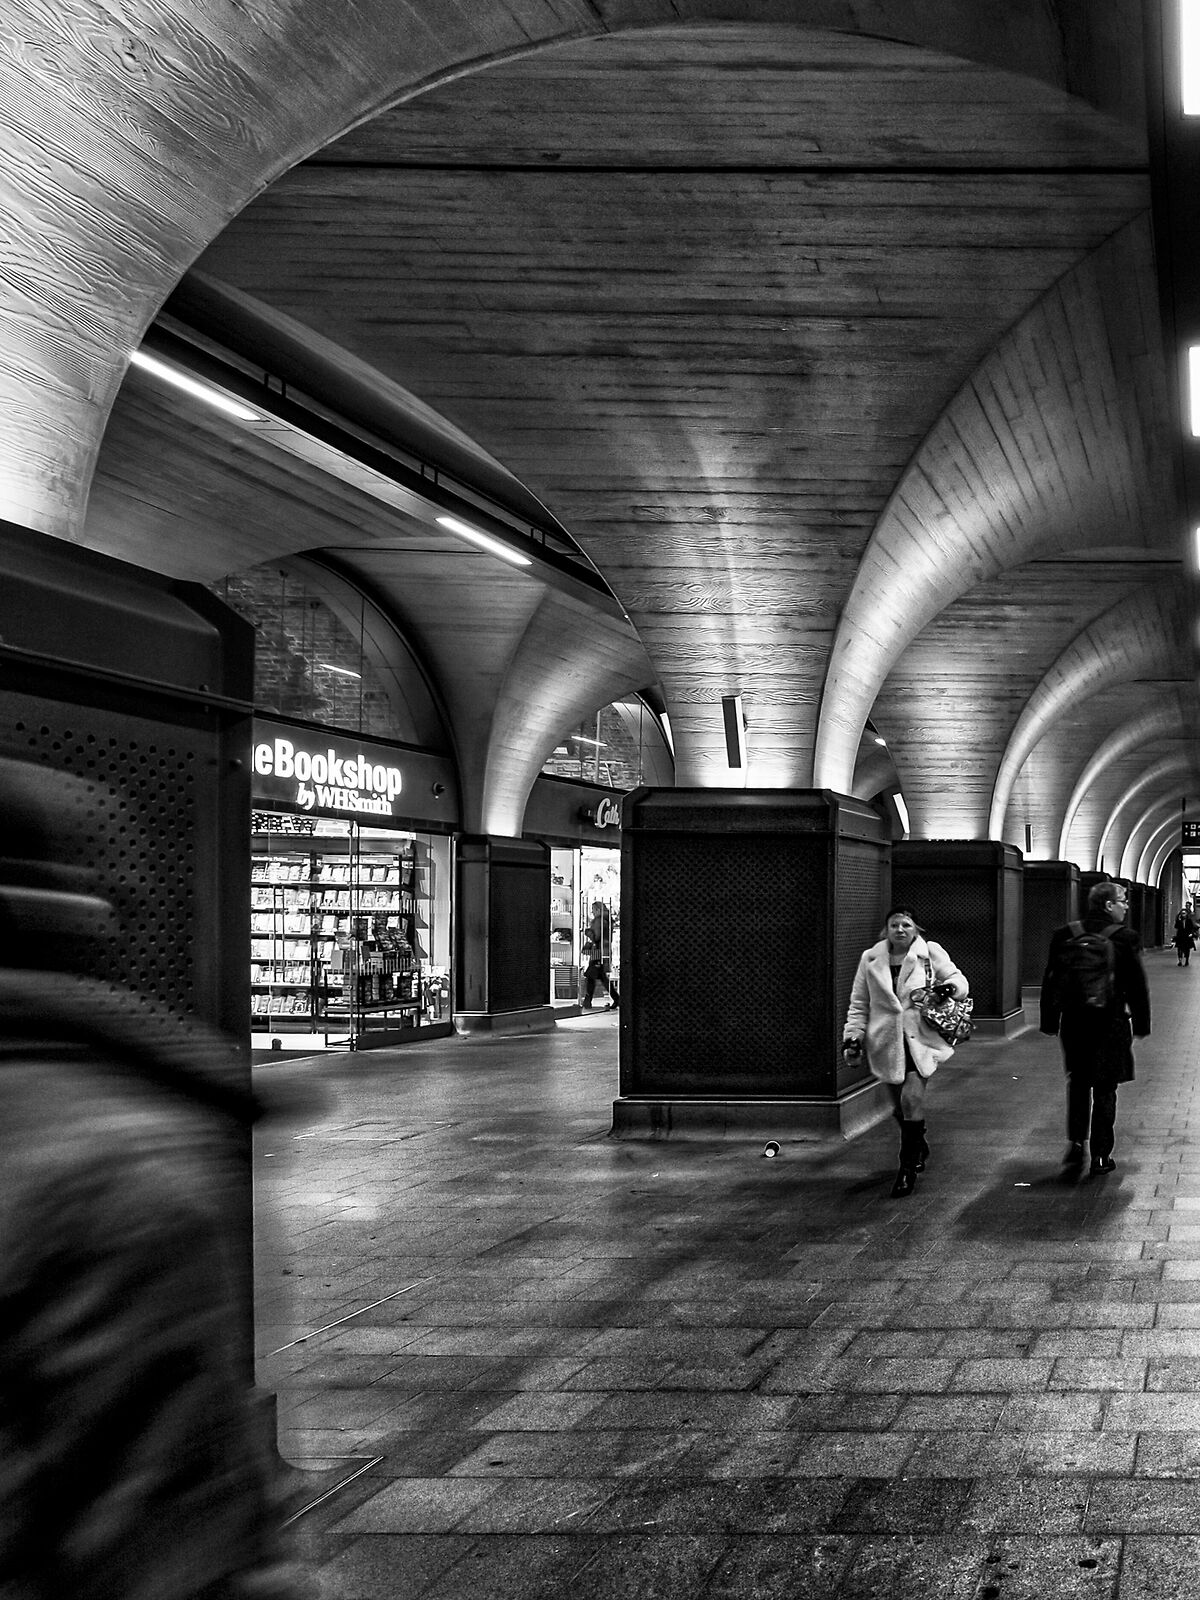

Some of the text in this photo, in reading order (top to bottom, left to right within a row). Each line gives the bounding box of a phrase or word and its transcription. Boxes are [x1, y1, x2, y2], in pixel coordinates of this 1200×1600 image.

[252, 738, 402, 801] eBookshop
[296, 782, 393, 815] by WHSmith
